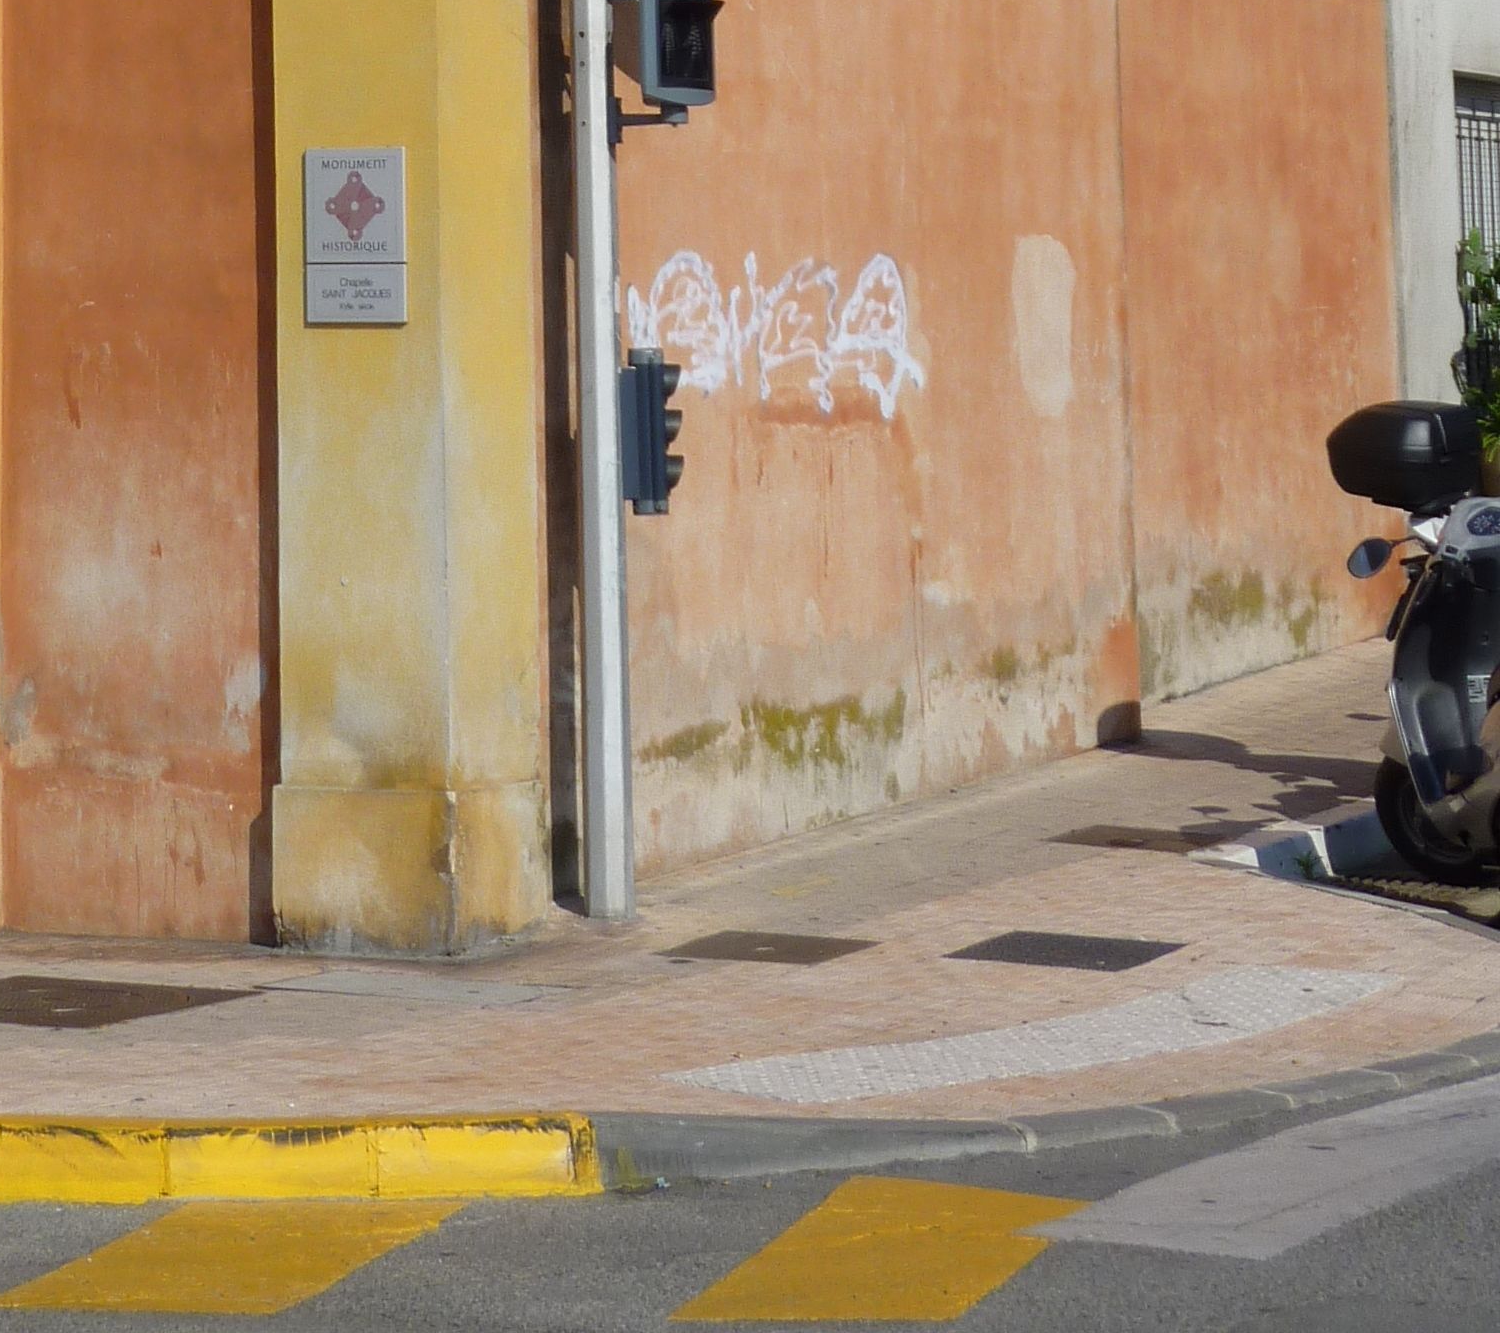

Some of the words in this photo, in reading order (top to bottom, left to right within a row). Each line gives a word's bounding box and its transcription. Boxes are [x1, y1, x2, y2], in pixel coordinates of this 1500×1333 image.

[320, 158, 388, 170] MONUMENT
[321, 240, 388, 253] HISTORIQUE
[321, 288, 346, 299] SAINT
[350, 288, 391, 299] JACQUES
